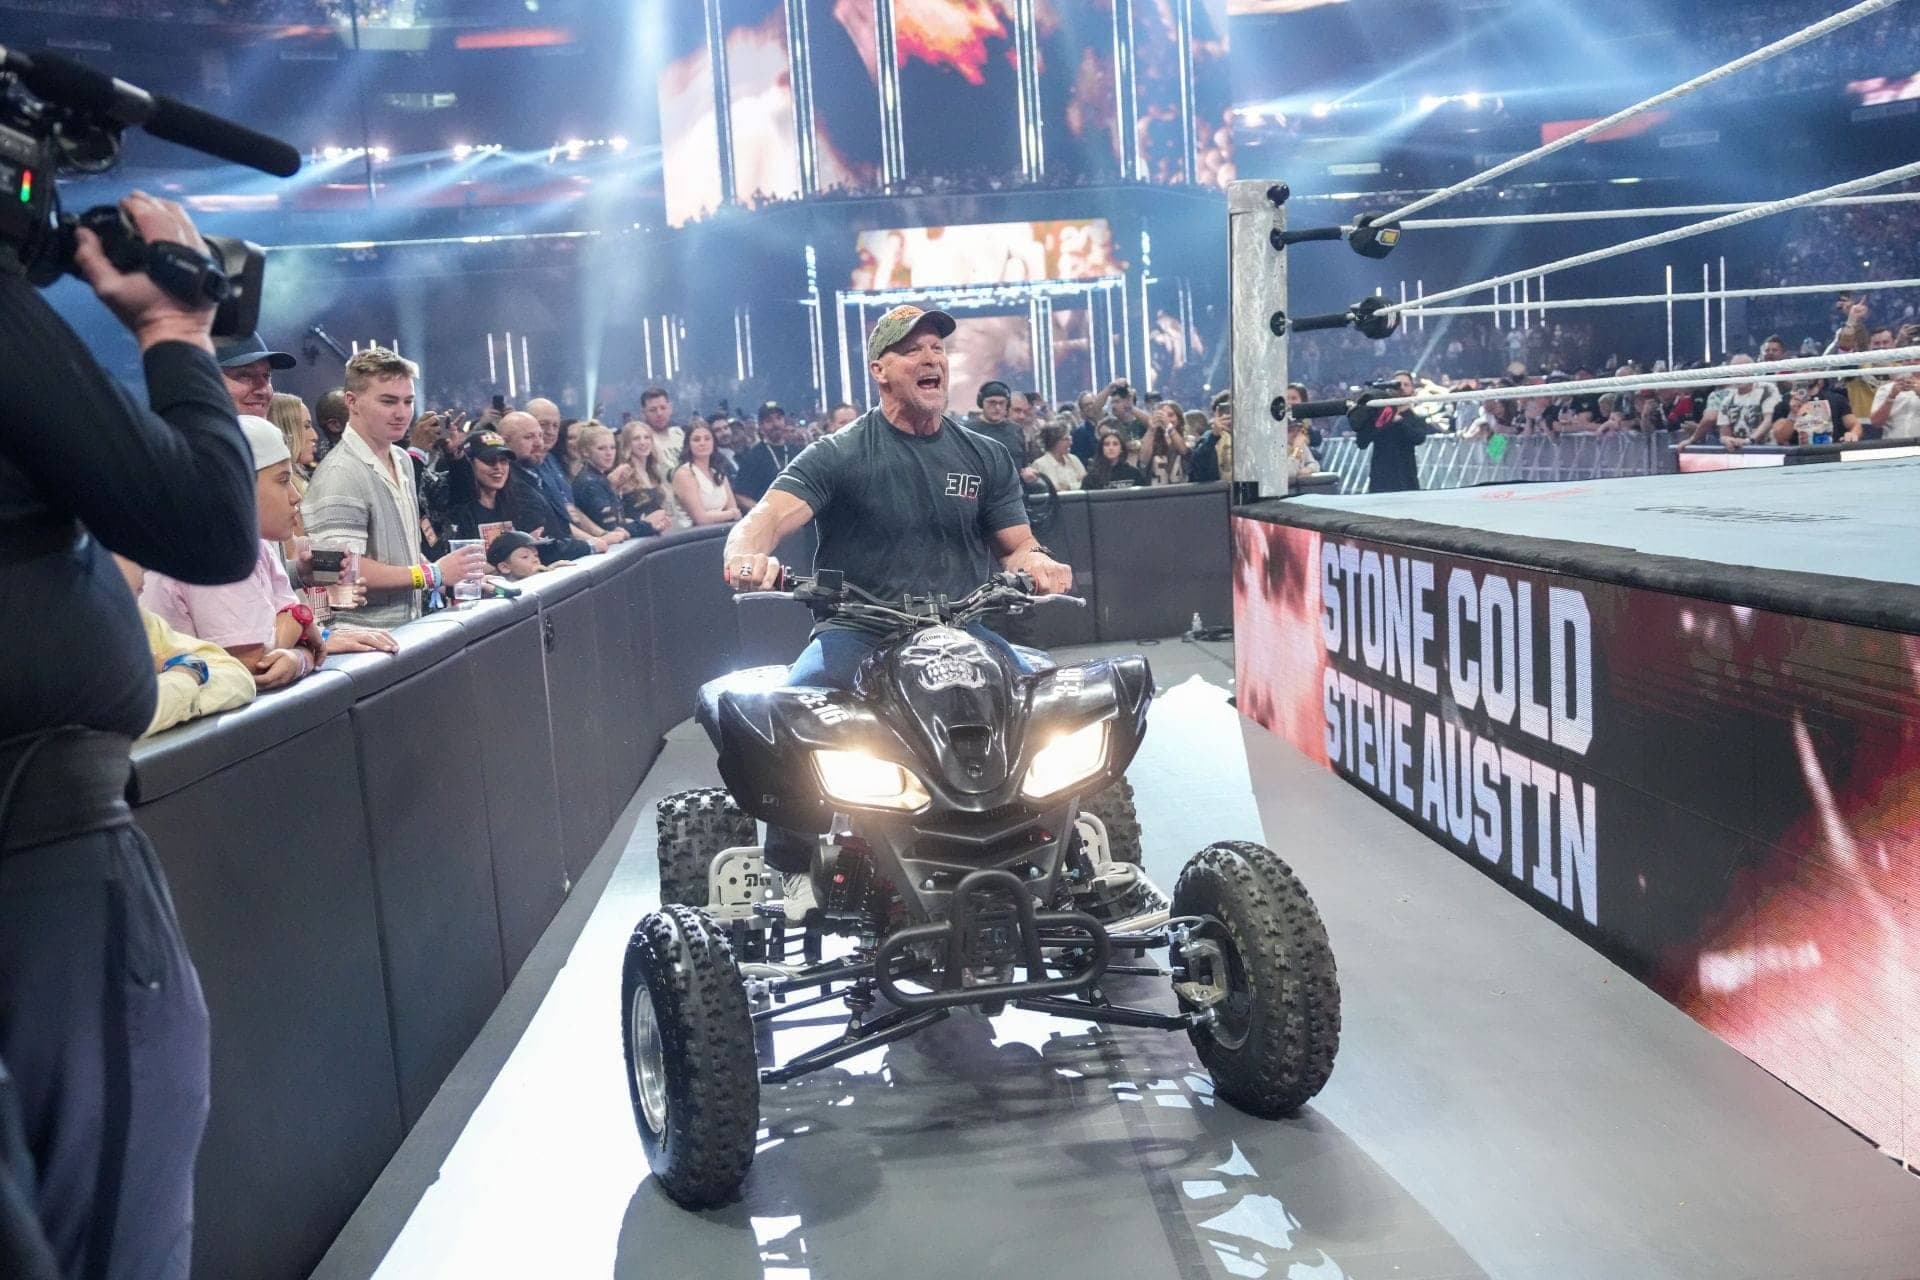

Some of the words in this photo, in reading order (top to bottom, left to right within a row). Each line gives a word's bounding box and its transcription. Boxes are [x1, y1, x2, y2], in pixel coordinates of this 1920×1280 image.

[945, 472, 981, 499] 316
[1320, 541, 1438, 695] STONE
[1447, 566, 1593, 756] COLD
[1053, 668, 1083, 697] 3:16
[797, 693, 850, 726] 3:16
[1322, 666, 1415, 812] STEVE
[1421, 711, 1598, 926] AUSTIN
